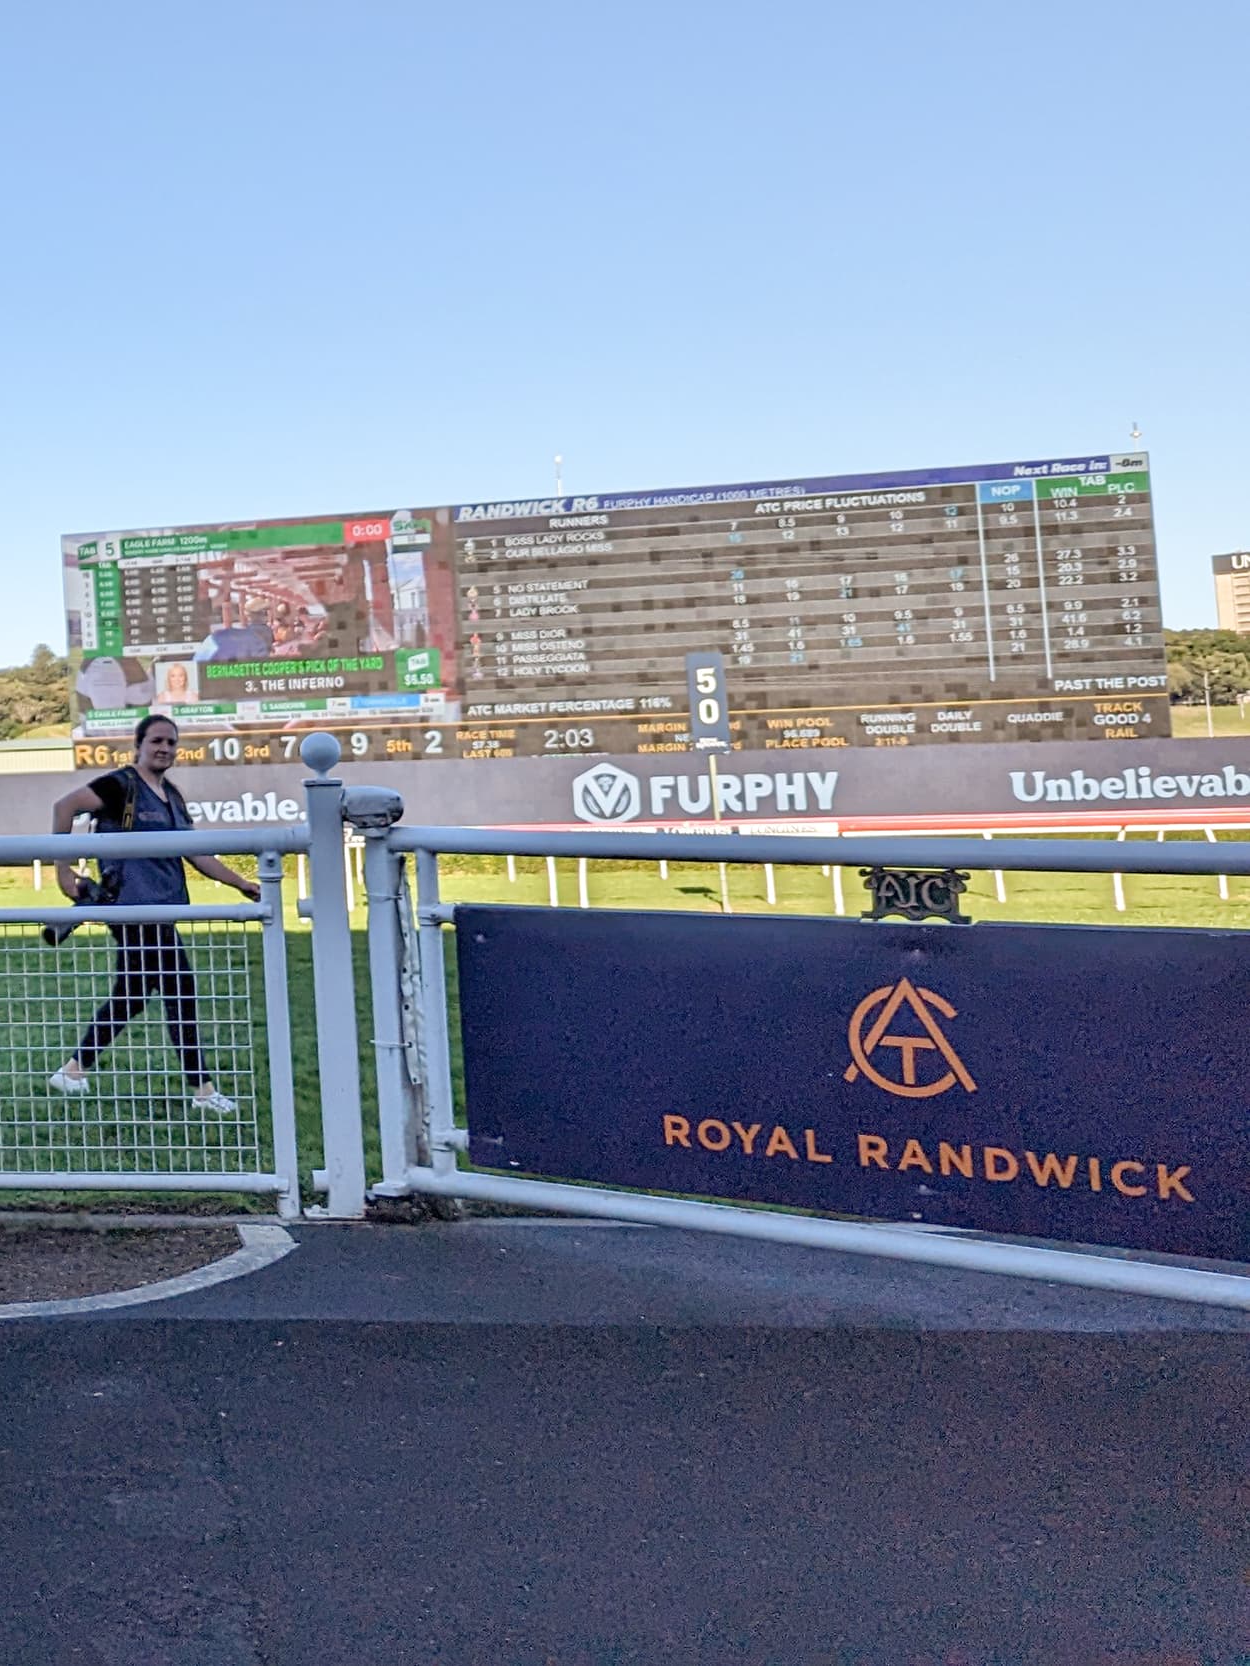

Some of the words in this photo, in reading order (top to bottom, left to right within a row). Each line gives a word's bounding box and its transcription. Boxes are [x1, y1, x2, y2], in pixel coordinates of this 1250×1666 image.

[1014, 465, 1048, 476] Next
[1078, 476, 1106, 486] TAB
[991, 485, 1021, 496] NOP
[1050, 487, 1078, 498] WIN
[1108, 483, 1135, 494] PLC
[457, 499, 570, 521] RANDWICK
[572, 497, 599, 512] R6
[604, 496, 650, 509] FURPHY
[654, 494, 713, 505] HANDICAP
[755, 502, 781, 513] ATC
[783, 499, 823, 511] PRICE
[825, 492, 926, 508] FLUCTUATIONS
[505, 536, 535, 547] BOSS
[536, 534, 565, 545] LADY
[566, 532, 605, 542] ROCKS
[890, 510, 903, 519] 10
[1002, 503, 1015, 512] 10
[1053, 499, 1077, 508] 10.4
[1118, 495, 1126, 504] 2
[549, 515, 609, 529] RUNNERS
[352, 524, 382, 536] 0:00
[105, 542, 114, 556] 5
[124, 541, 150, 550] EAGLE
[152, 538, 175, 547] FARM
[180, 536, 208, 545] 1200m
[508, 585, 525, 593] NO
[526, 580, 589, 592] STATEMENT
[510, 607, 536, 617] LADY
[511, 631, 537, 640] MISS
[540, 629, 566, 639] DIOR
[206, 662, 261, 678] BERNADETTE
[327, 659, 340, 671] OF
[341, 657, 358, 670] THE
[359, 656, 383, 670] YARD
[245, 681, 258, 692] 3.
[260, 679, 285, 691] THE
[288, 676, 344, 689] INFERNO
[1054, 679, 1091, 691] PAST
[1093, 677, 1124, 689] THE
[1127, 675, 1167, 687] POST
[467, 705, 492, 716] ATC
[494, 702, 547, 714] MARKET
[549, 698, 635, 712] PERCENTAGE
[1094, 702, 1143, 713] TRACK
[937, 710, 972, 720] DAILY
[1007, 711, 1064, 723] QUADDIE
[1093, 713, 1139, 725] GOOD
[1142, 713, 1152, 723] 4
[637, 722, 687, 733] MARGIN
[767, 719, 792, 729] WIN
[796, 717, 833, 727] POOL
[866, 724, 915, 734] DOUBLE
[930, 721, 981, 732] DOUBLE
[456, 731, 487, 741] RACE
[489, 729, 517, 739] TIME
[544, 728, 594, 748] 2:03
[1105, 727, 1138, 738] RAIL
[75, 745, 109, 764] R6
[112, 751, 133, 763] 1st
[177, 747, 205, 761] 2nd
[208, 738, 240, 760] 10
[244, 745, 269, 758] 3rd
[280, 736, 297, 758] 7
[350, 732, 368, 755] 9
[386, 739, 412, 753] 5th
[424, 730, 443, 753] 2
[637, 743, 686, 753] MARGIN
[766, 738, 807, 748] PLACE
[812, 737, 848, 747] POOL
[462, 749, 491, 758] LAST
[1008, 764, 1250, 802] Unbelievab
[650, 771, 838, 815] FURPHY
[663, 1113, 833, 1164] ROYAL
[858, 1133, 1195, 1203] RANDWICK
